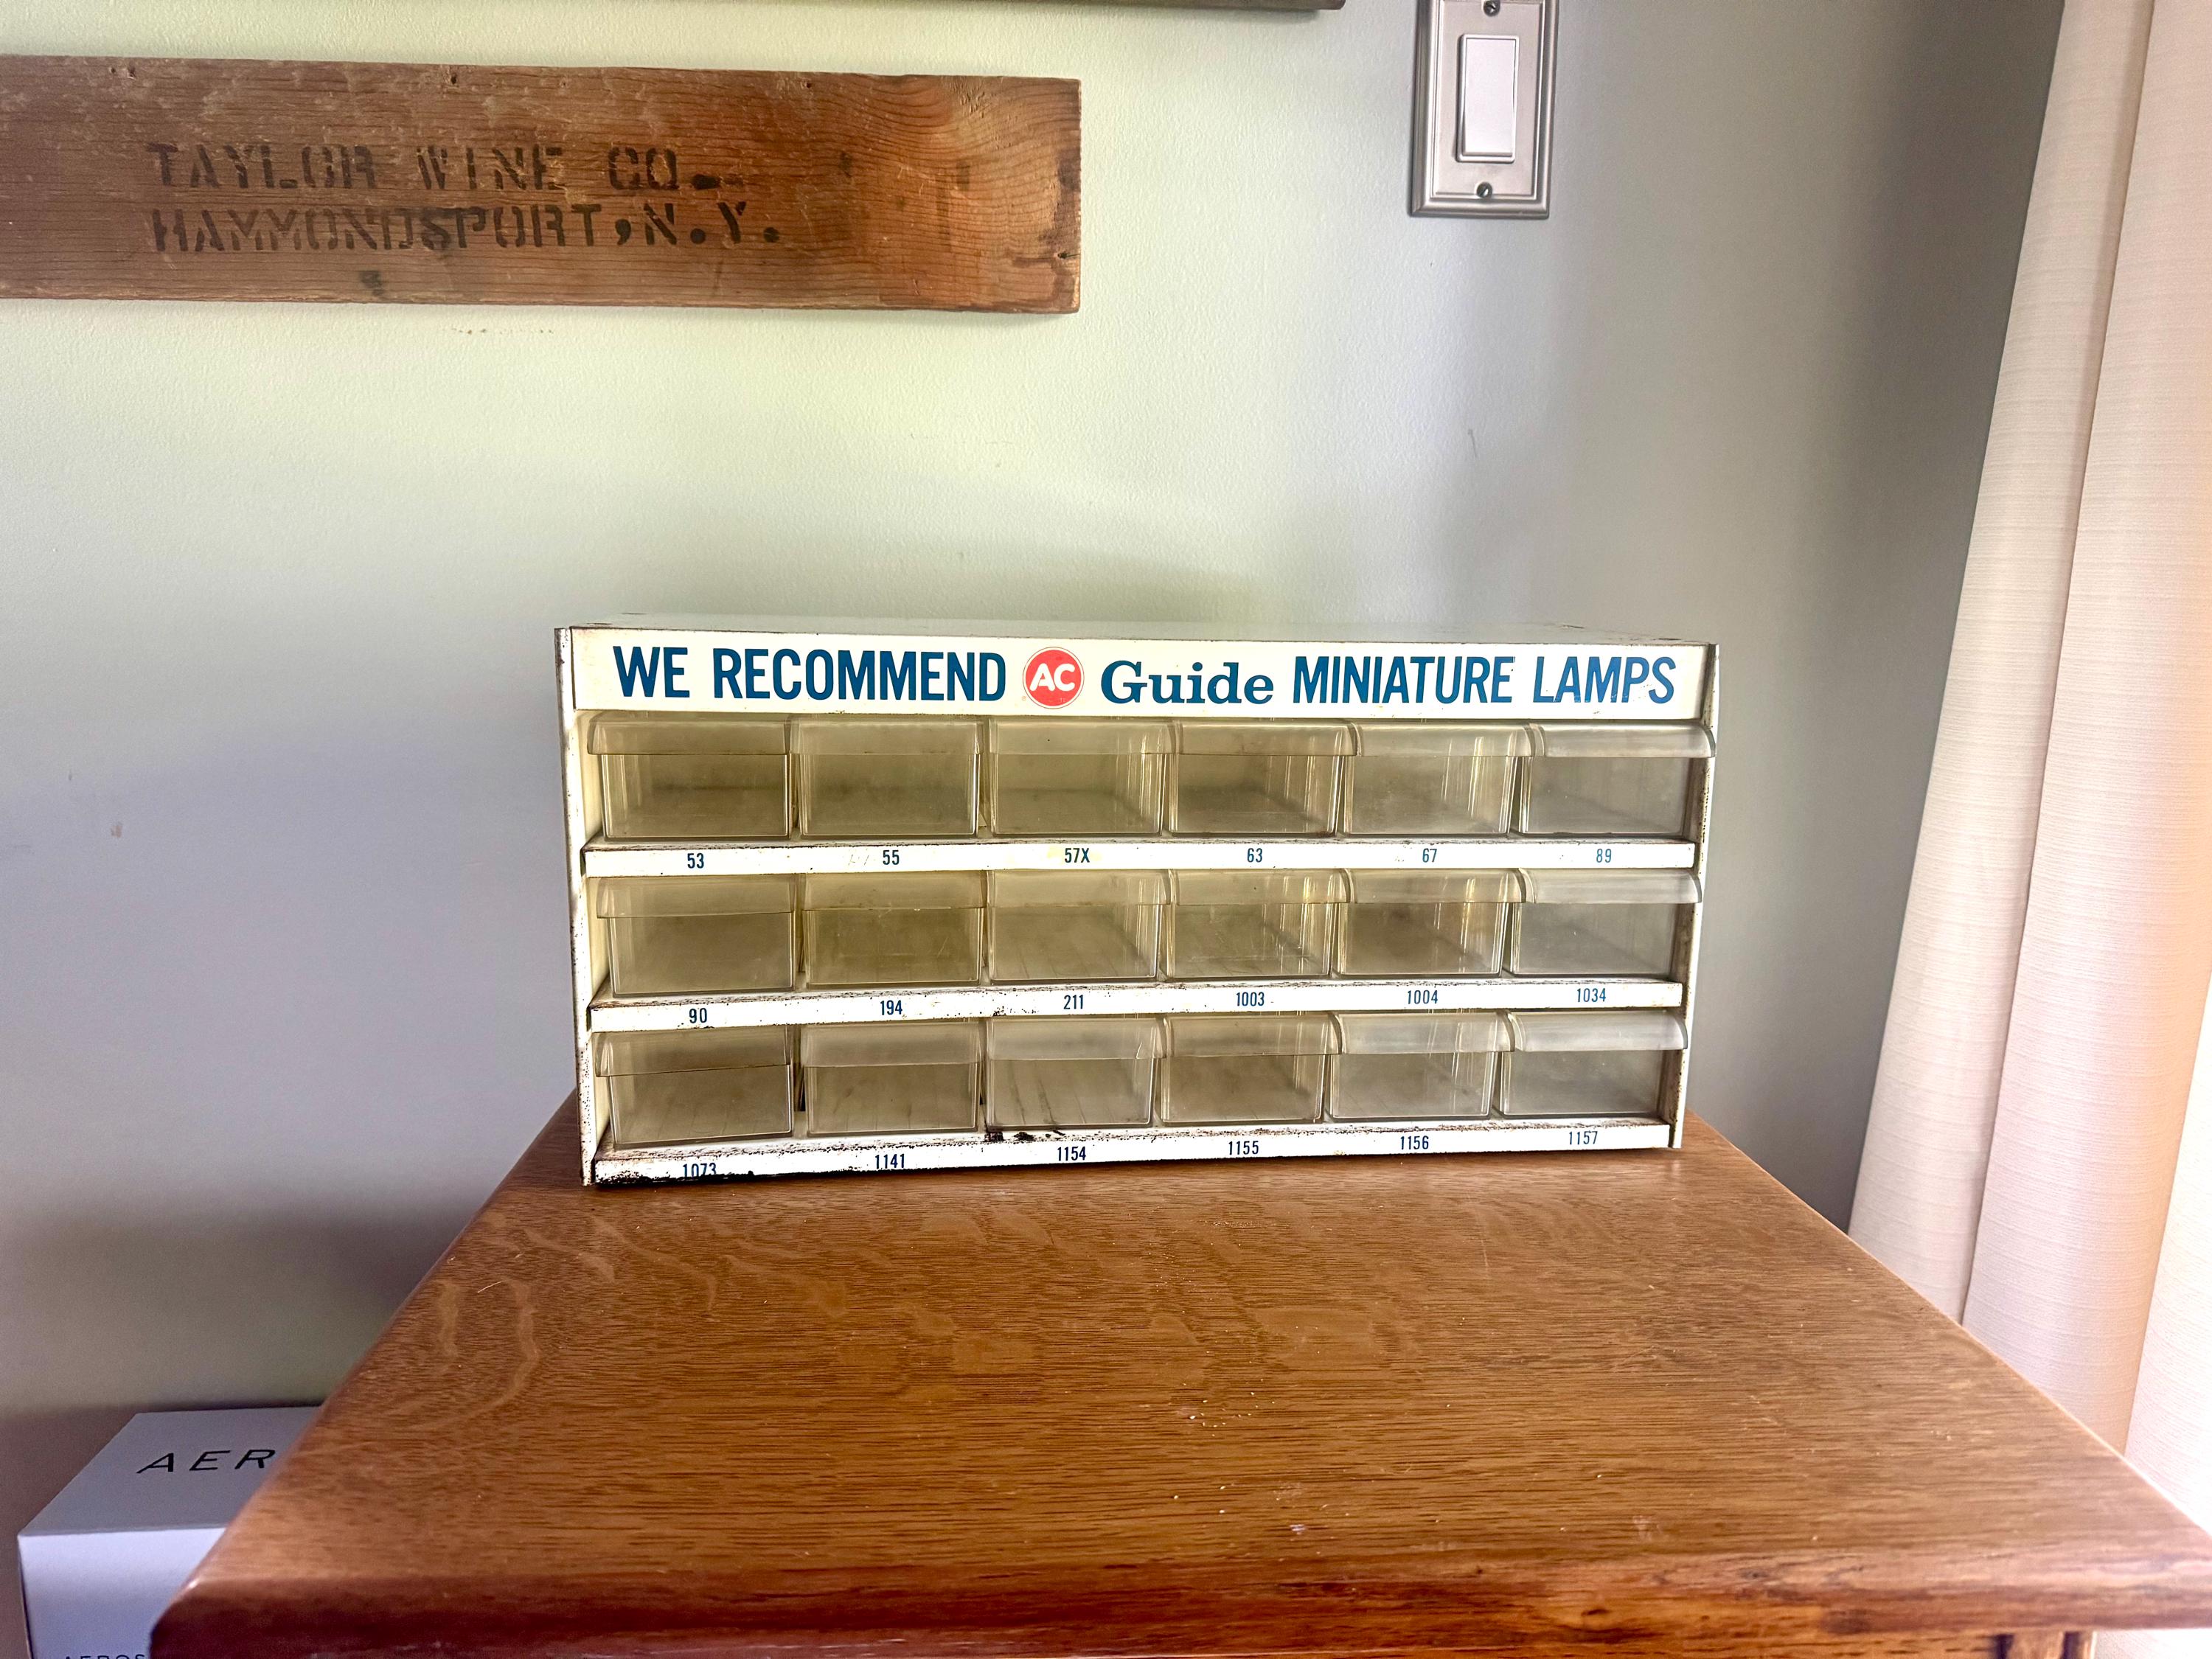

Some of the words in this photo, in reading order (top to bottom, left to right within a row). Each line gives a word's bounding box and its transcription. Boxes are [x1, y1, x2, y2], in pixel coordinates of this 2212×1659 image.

[149, 143, 378, 189] TAYLOR
[417, 147, 563, 191] WINE
[612, 645, 690, 698] WE
[712, 647, 1006, 701] RECOMMEND
[1029, 663, 1076, 692] AC
[1100, 660, 1274, 705] Guide
[1293, 655, 1516, 704] MINIATURE
[1532, 656, 1677, 704] LAMPS
[686, 853, 705, 869] 53
[883, 849, 900, 866] 55
[1064, 847, 1091, 863] 57X
[1247, 847, 1263, 863] 63
[1422, 848, 1437, 863] 67
[1596, 848, 1612, 863] 89
[1063, 994, 1083, 1010] 211
[1236, 991, 1265, 1006] 1003
[1408, 990, 1439, 1004] 1004
[1576, 987, 1607, 1003] 1034
[689, 1007, 708, 1024] 90
[880, 1000, 902, 1016] 194
[1400, 1135, 1429, 1150] 1156
[1569, 1130, 1598, 1145] 1157
[1057, 1146, 1087, 1162] 1154
[1228, 1140, 1260, 1156] 1155
[874, 1153, 905, 1170] 1141
[682, 1162, 717, 1178] 1073
